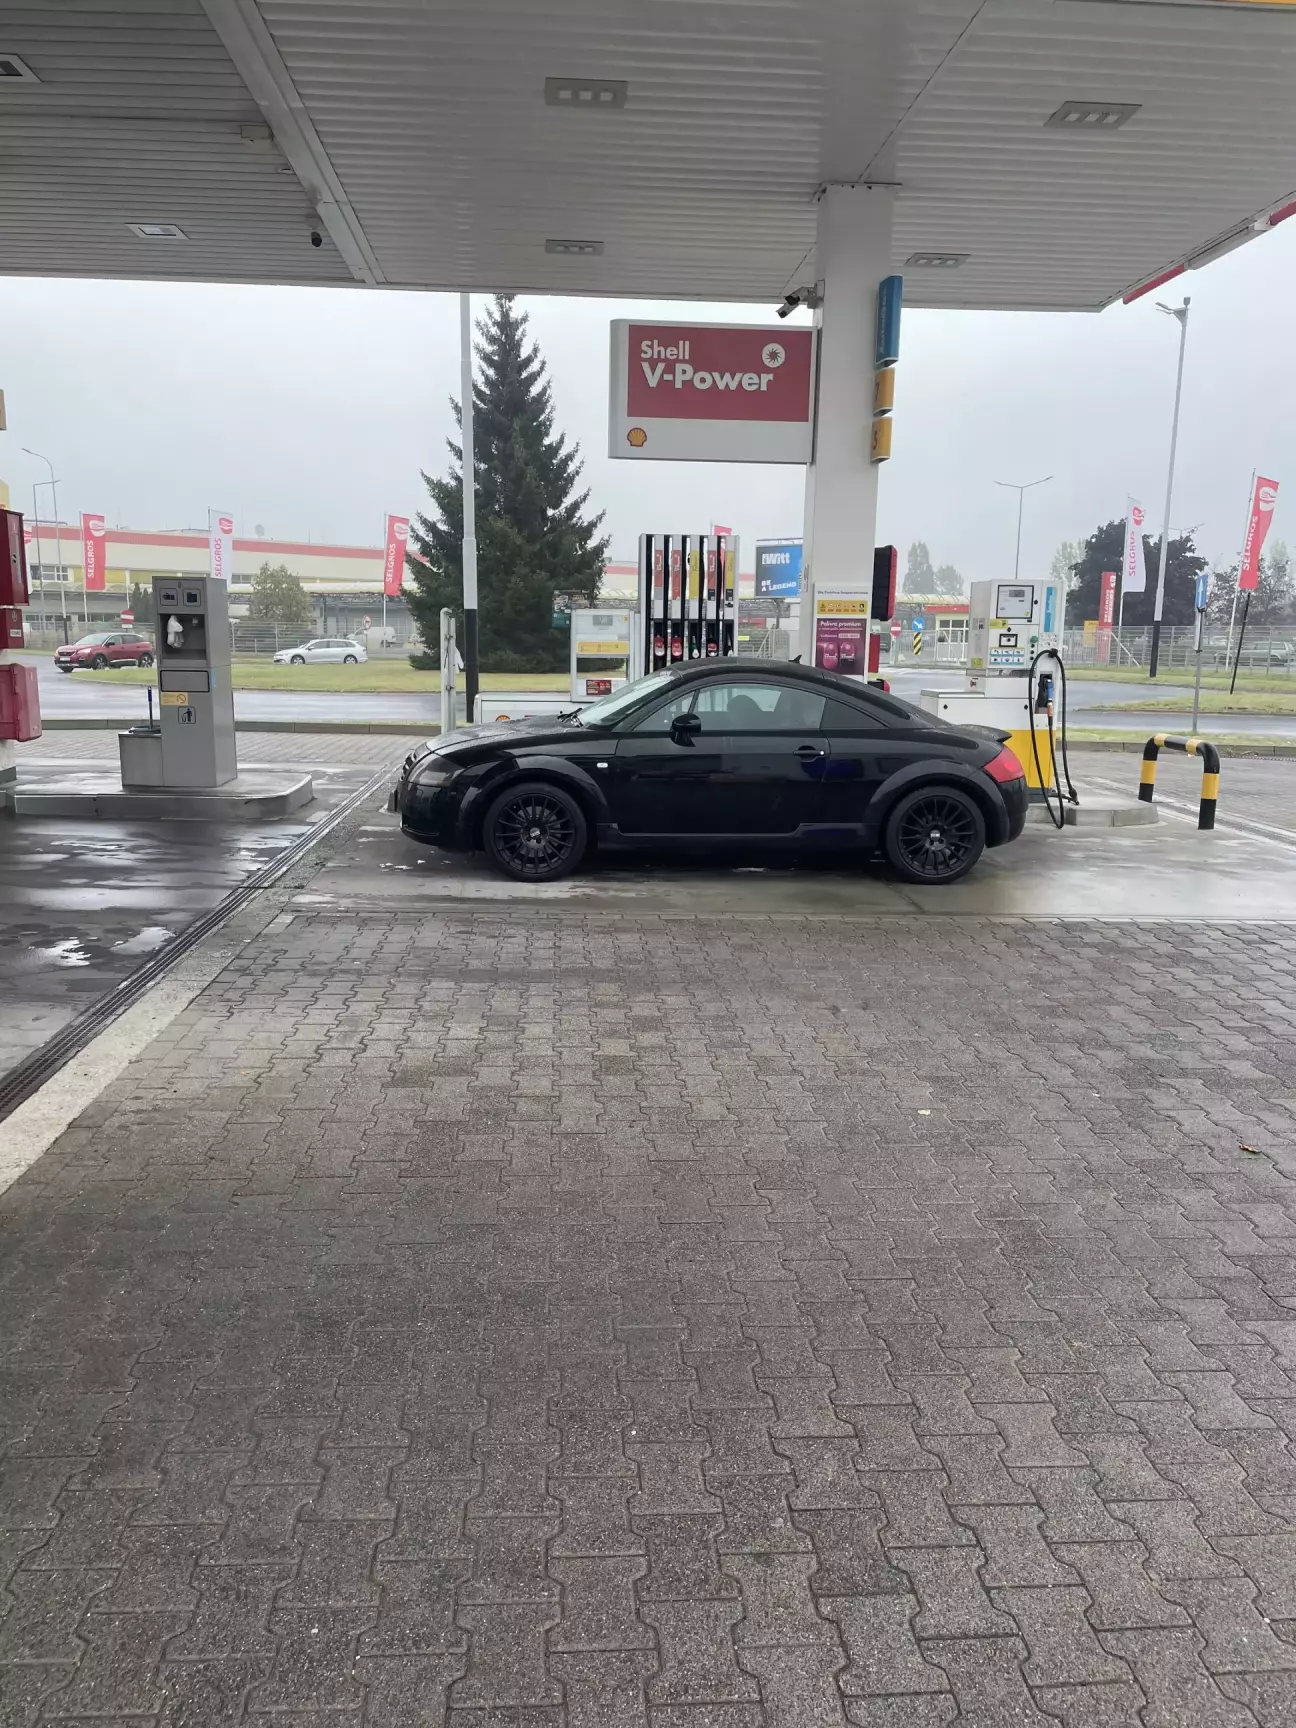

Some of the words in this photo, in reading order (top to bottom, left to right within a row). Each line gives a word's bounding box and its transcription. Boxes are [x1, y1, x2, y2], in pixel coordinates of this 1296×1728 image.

[641, 340, 690, 360] Shell
[641, 362, 773, 391] V-Power
[87, 540, 95, 578] SELGROS
[214, 537, 222, 577] SELGROS
[386, 543, 396, 583] SELGROS
[1128, 531, 1136, 577] SELGROS
[1243, 516, 1258, 571] SELGROS
[768, 581, 797, 591] LEGEND
